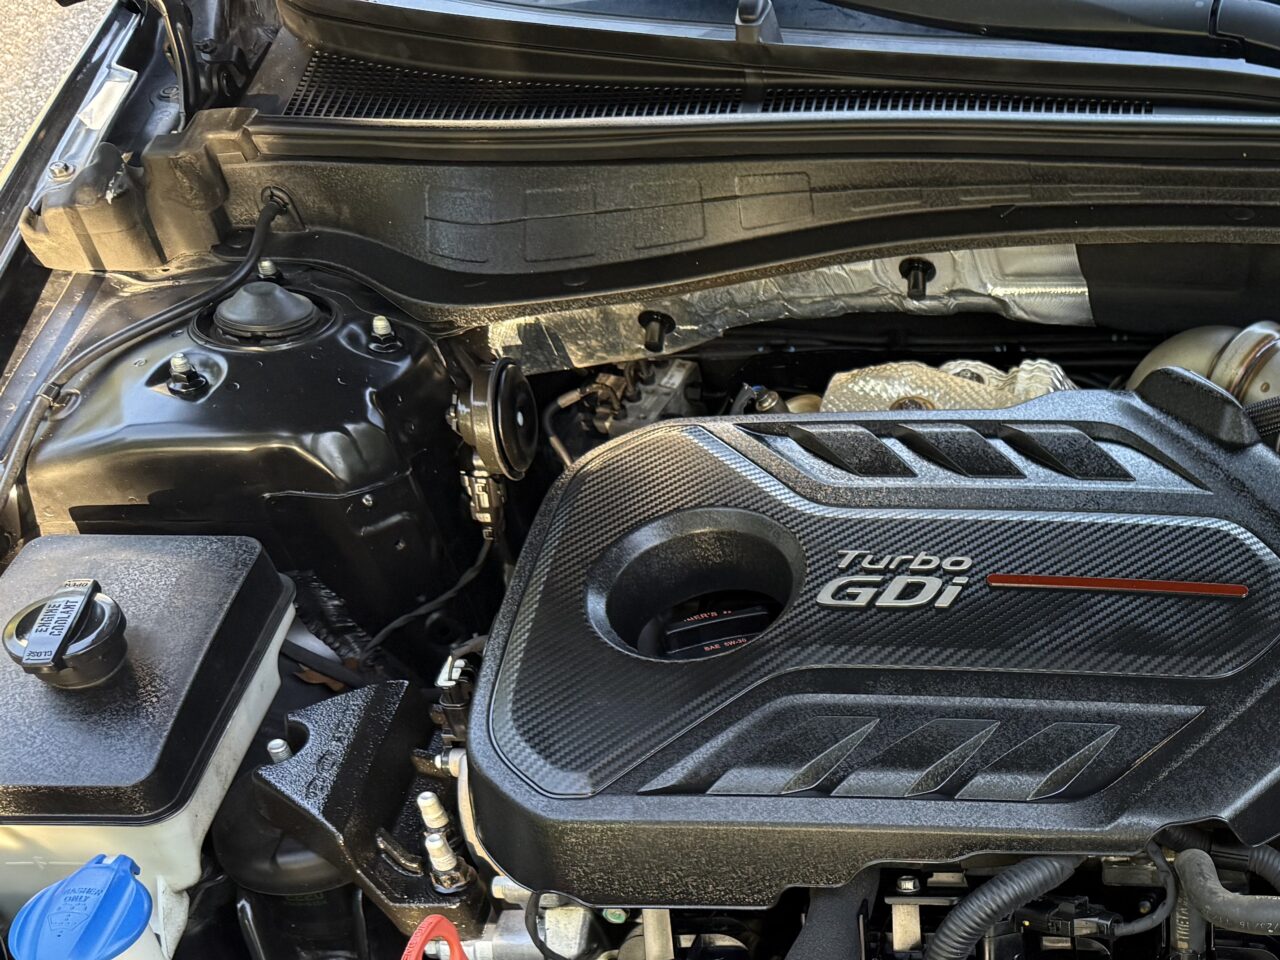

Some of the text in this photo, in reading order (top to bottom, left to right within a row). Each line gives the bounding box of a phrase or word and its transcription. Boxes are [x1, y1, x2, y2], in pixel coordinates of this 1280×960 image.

[837, 550, 973, 570] Turbo
[816, 575, 969, 608] GDi
[35, 603, 62, 633] ENGINE
[49, 599, 78, 637] COOLANT
[26, 650, 53, 658] CLOSE
[703, 643, 721, 652] SAE
